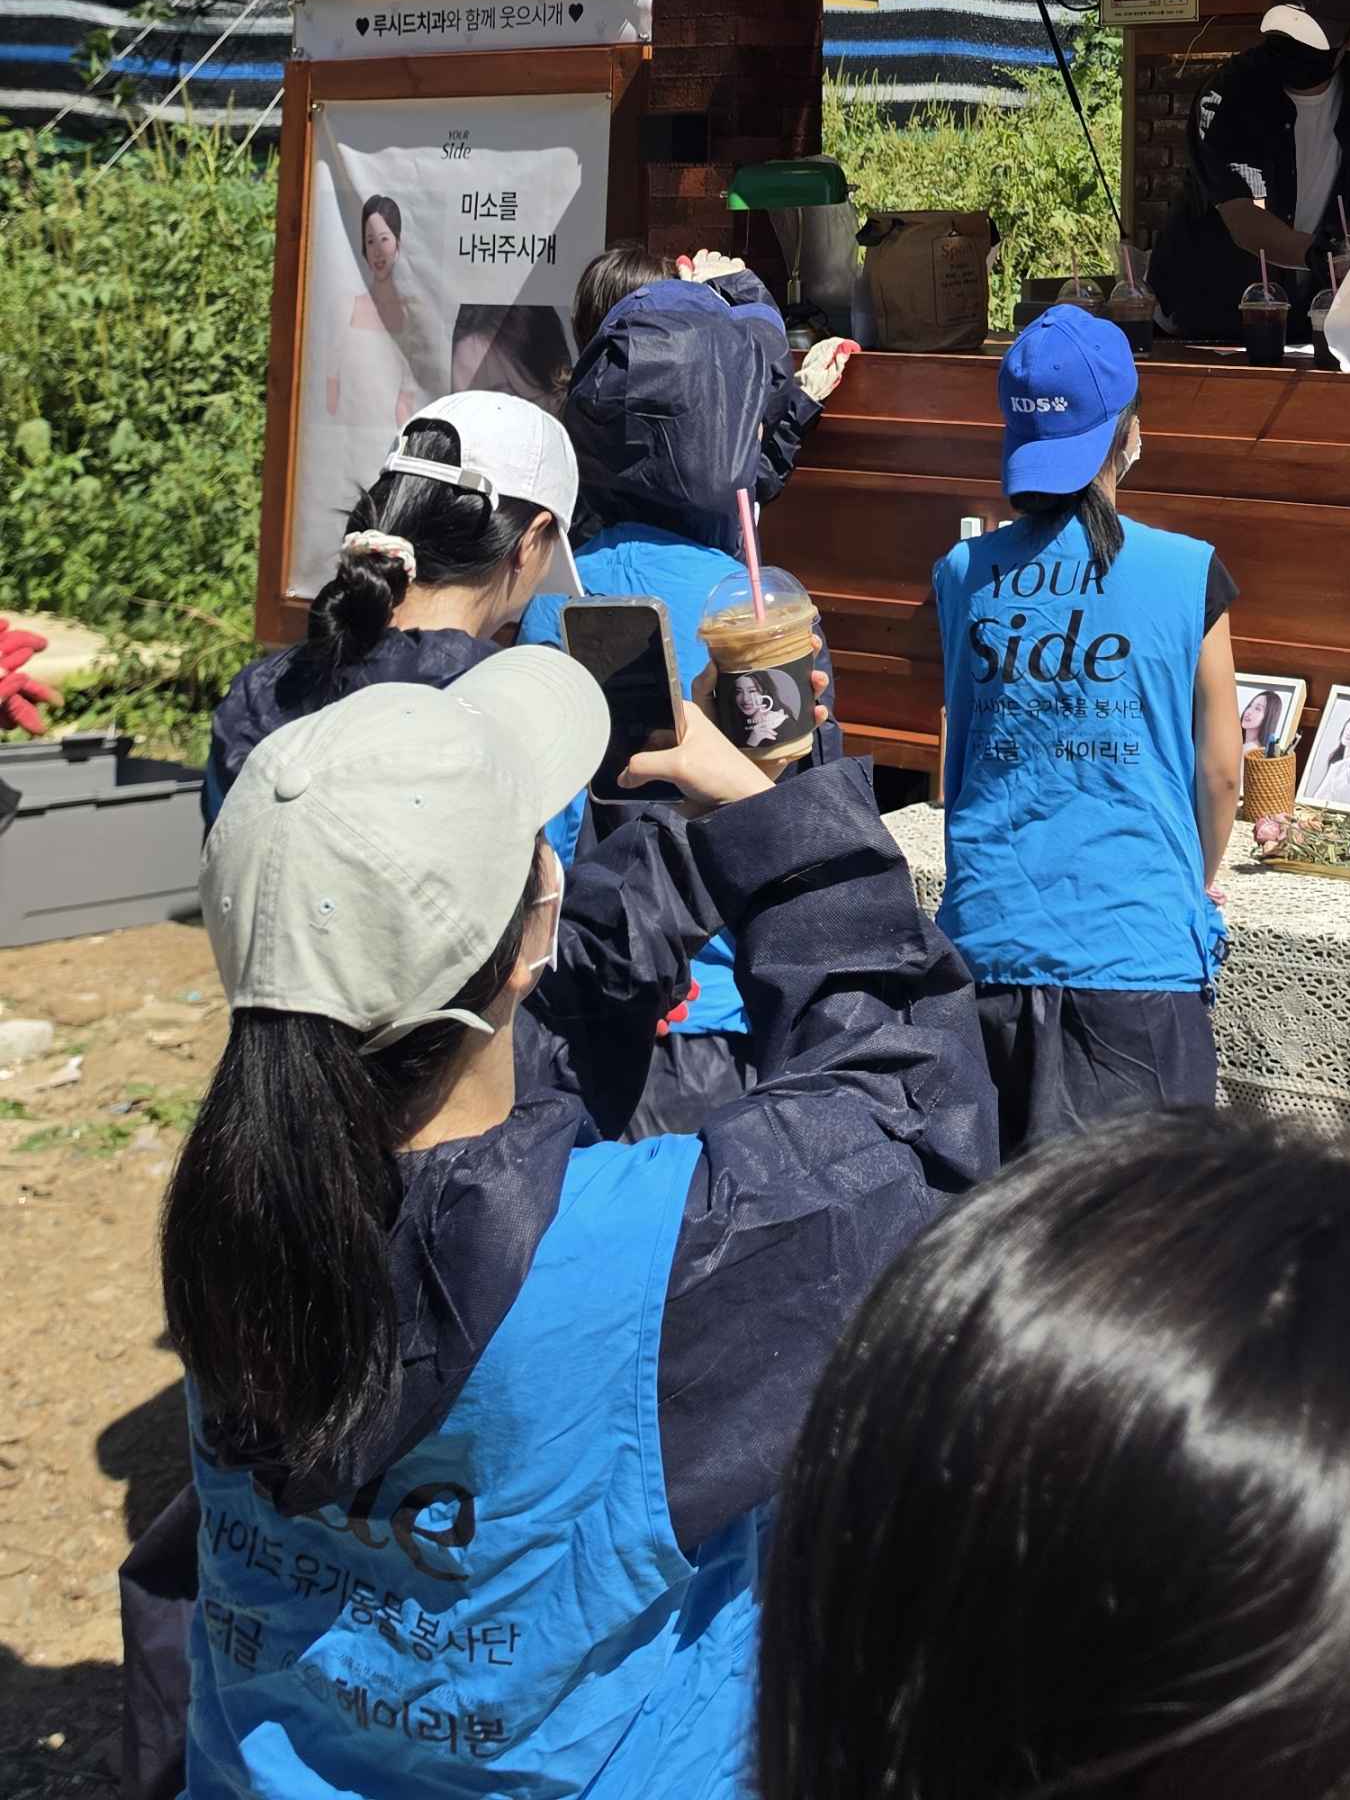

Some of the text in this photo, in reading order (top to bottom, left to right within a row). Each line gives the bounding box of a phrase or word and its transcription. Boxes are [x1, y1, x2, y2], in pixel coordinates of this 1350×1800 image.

[373, 1, 564, 38] 루시드치과와 함께 웃으시개
[441, 141, 472, 160] Side
[461, 190, 519, 221] 미소를
[459, 233, 557, 265] 나눠주시개
[1010, 396, 1051, 413] KDS
[991, 559, 1105, 599] YOUR
[968, 609, 1131, 685] Side
[1094, 698, 1143, 720] 봉사단
[1055, 739, 1141, 766] 헤이리본
[409, 1611, 521, 1666] 봉사단
